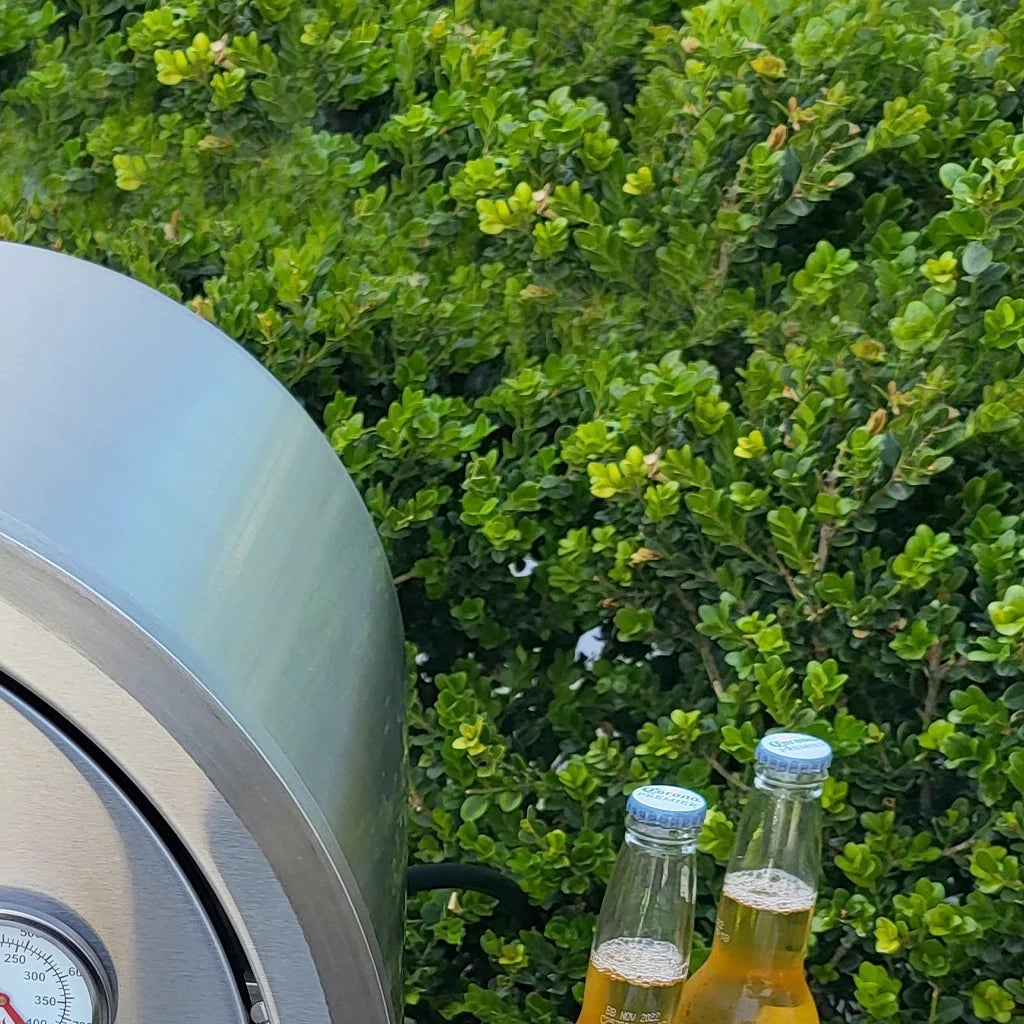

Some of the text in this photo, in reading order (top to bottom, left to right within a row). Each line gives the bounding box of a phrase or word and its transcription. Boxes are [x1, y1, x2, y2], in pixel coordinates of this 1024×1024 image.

[5, 953, 26, 965] 250
[24, 971, 46, 981] 300
[35, 995, 56, 1006] 350
[620, 1011, 636, 1021] NOV
[640, 1012, 660, 1022] 2022
